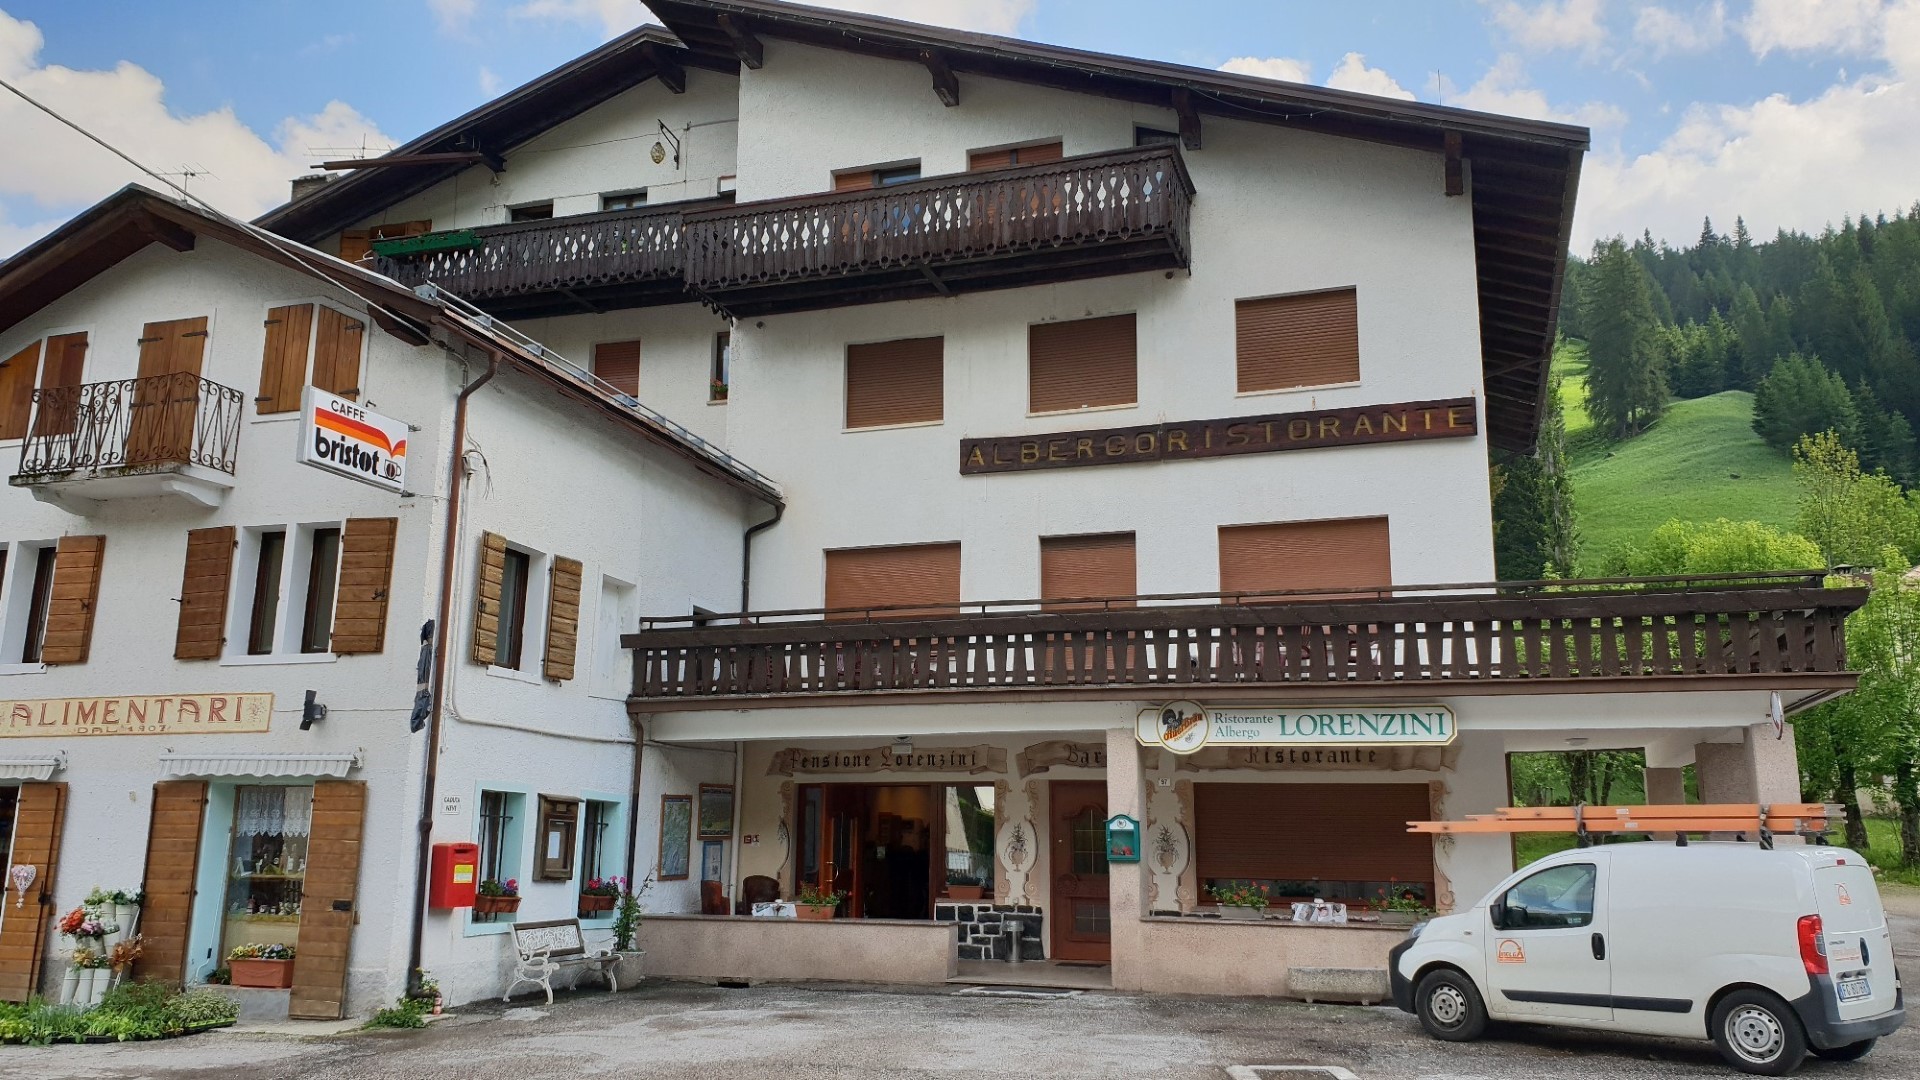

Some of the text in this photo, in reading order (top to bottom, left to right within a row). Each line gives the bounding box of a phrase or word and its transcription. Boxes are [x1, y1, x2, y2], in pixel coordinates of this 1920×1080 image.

[966, 404, 1473, 467] ALBERGO RISTORANTE
[315, 427, 380, 476] bristot
[10, 696, 243, 727] ALIMENTARI
[1214, 712, 1274, 724] Ristorante
[77, 726, 118, 734] DAL
[1214, 725, 1260, 740] Albergo
[1278, 712, 1448, 736] LORENZINI
[1244, 746, 1376, 764] Ristorante
